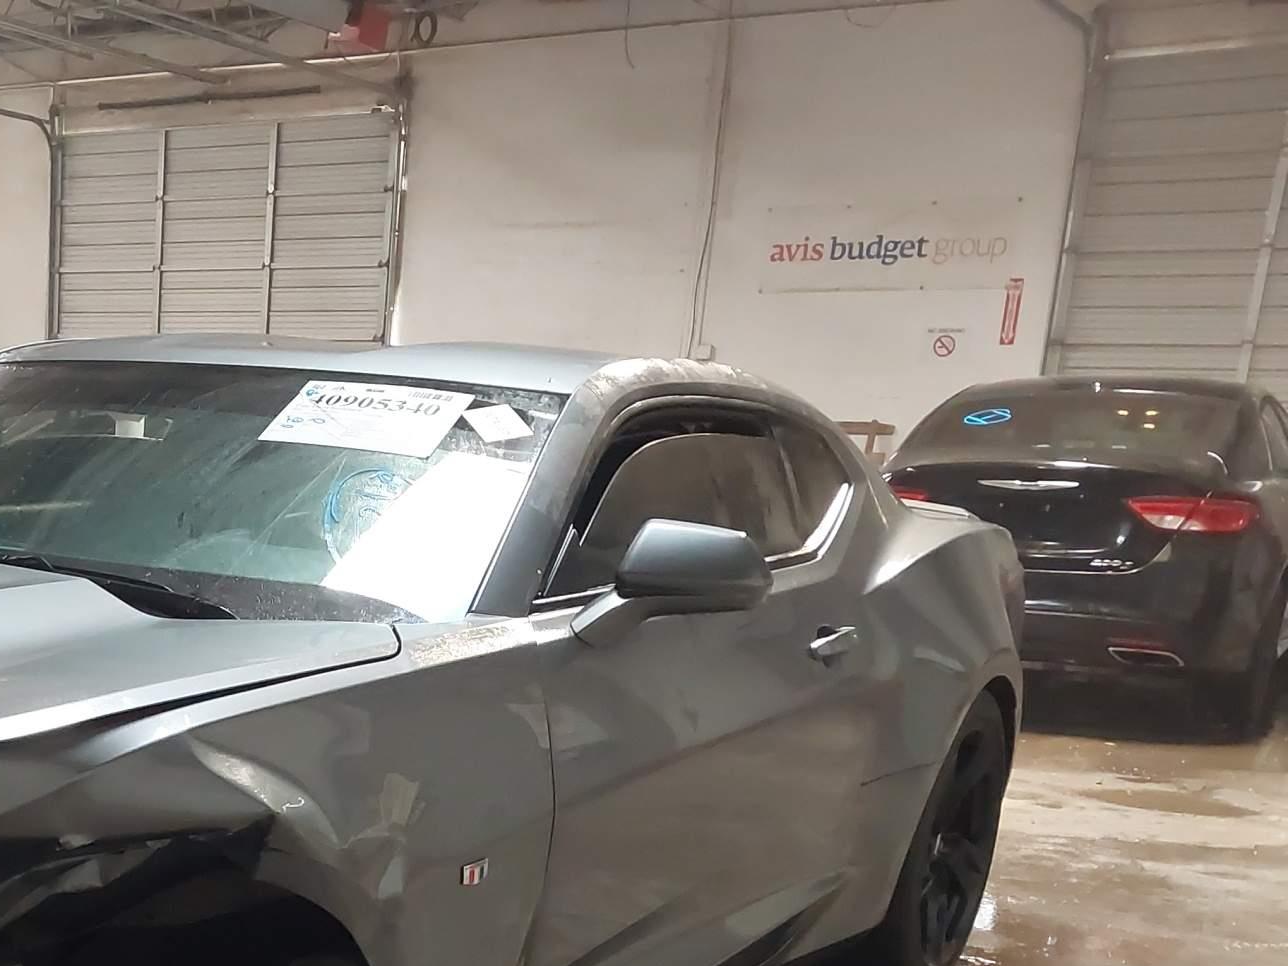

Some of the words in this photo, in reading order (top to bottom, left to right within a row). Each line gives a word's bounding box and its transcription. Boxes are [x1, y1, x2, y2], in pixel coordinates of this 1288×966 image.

[770, 237, 824, 262] avis
[830, 235, 928, 265] budget
[931, 236, 1008, 265] group
[312, 393, 441, 416] 40905340
